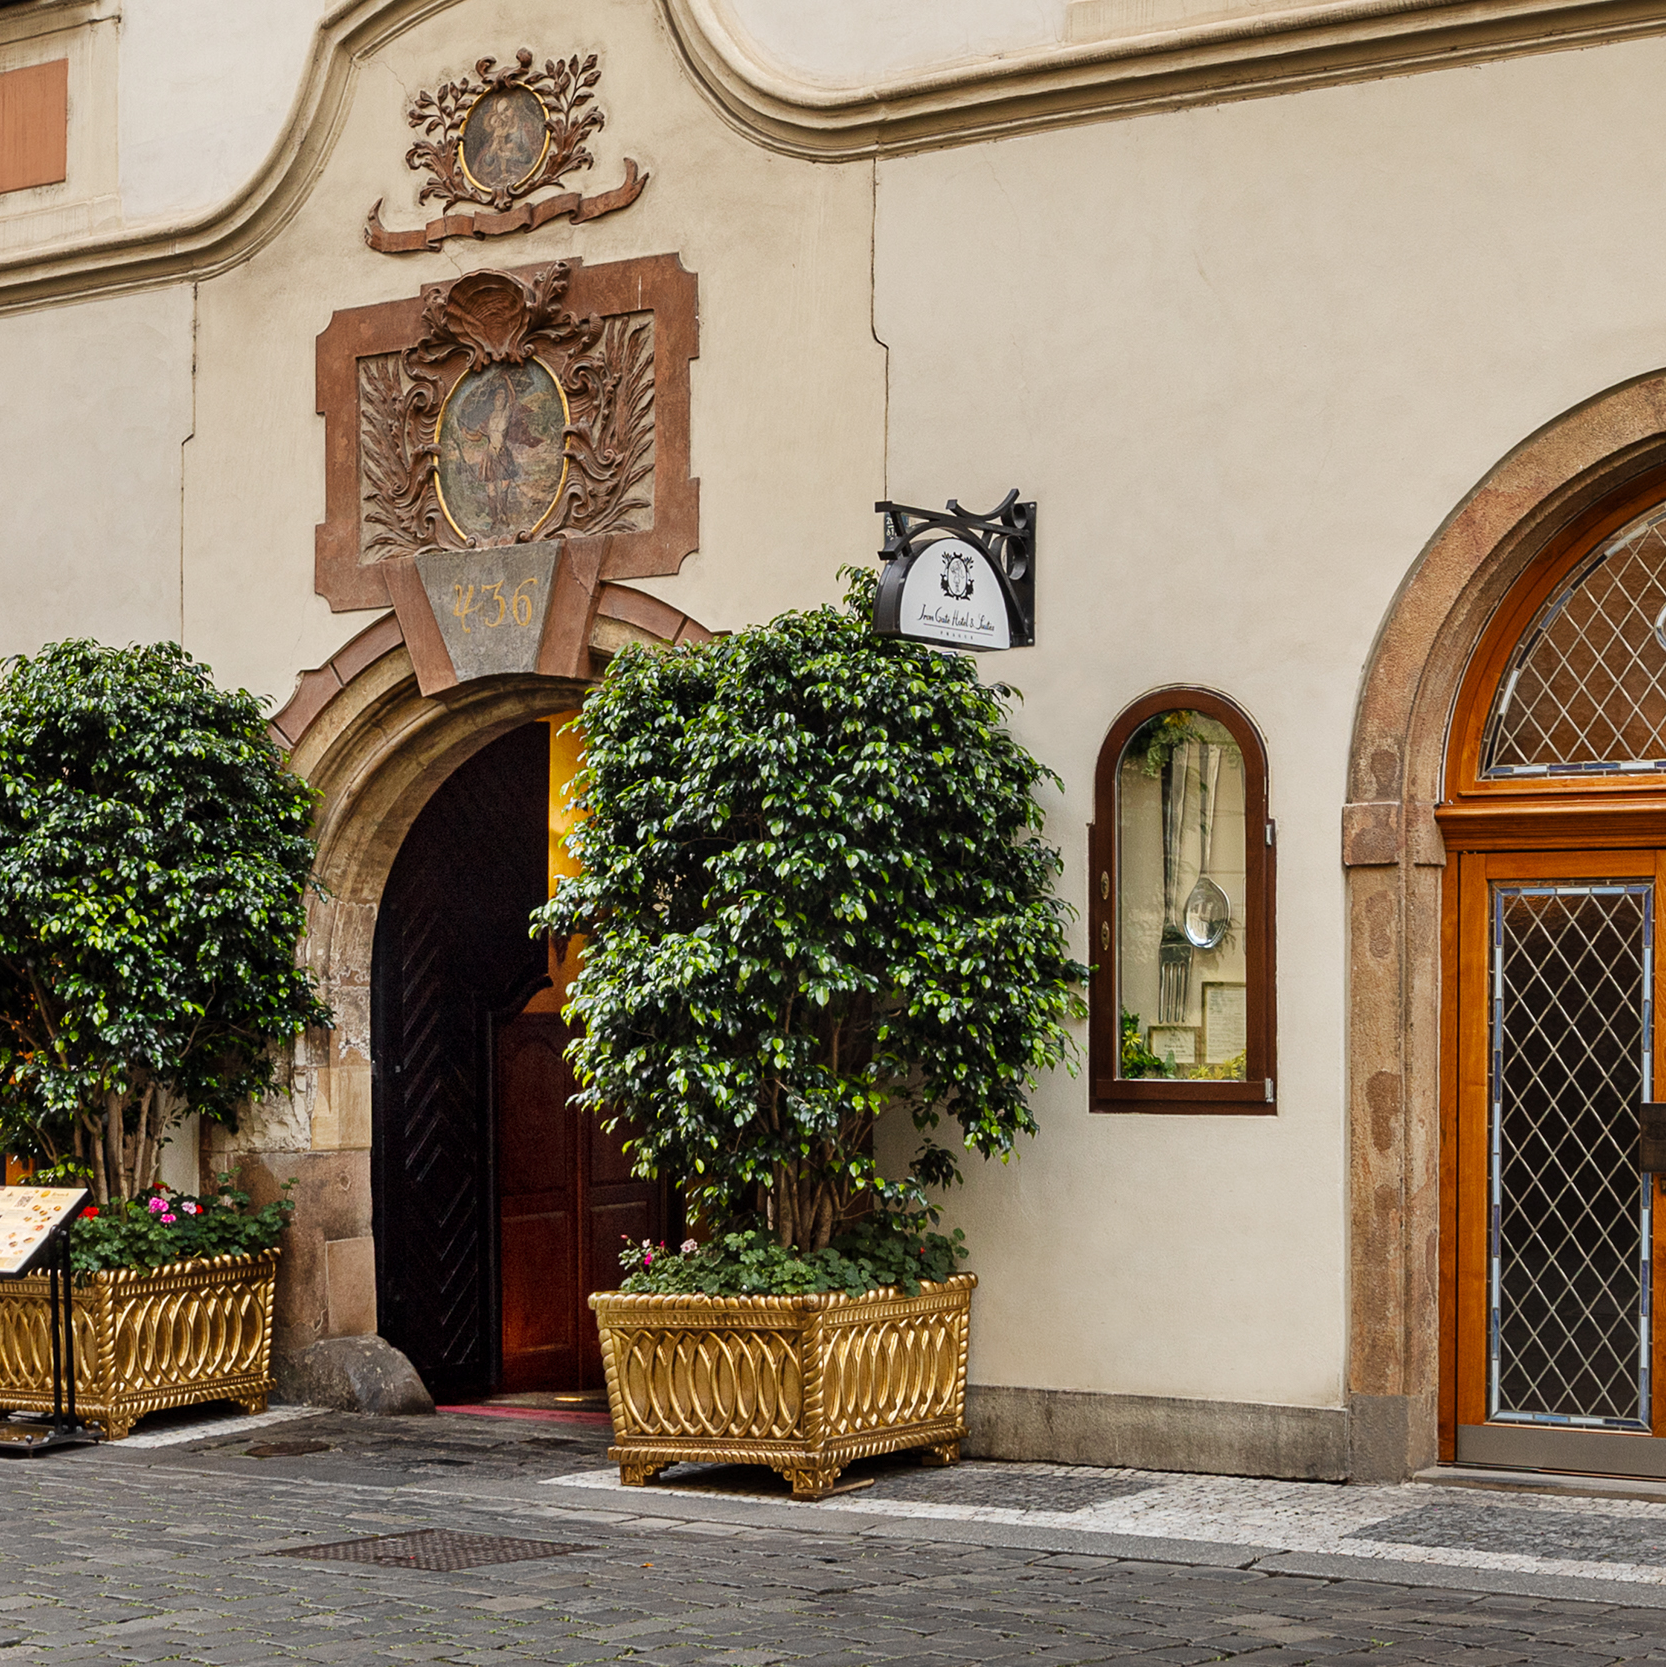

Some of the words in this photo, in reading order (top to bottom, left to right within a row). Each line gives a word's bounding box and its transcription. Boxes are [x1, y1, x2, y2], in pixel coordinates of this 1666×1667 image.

[454, 577, 538, 634] 436
[917, 604, 934, 621] Iron
[934, 606, 950, 624] Gate
[952, 609, 969, 627] Hotel
[973, 613, 995, 631] Suites
